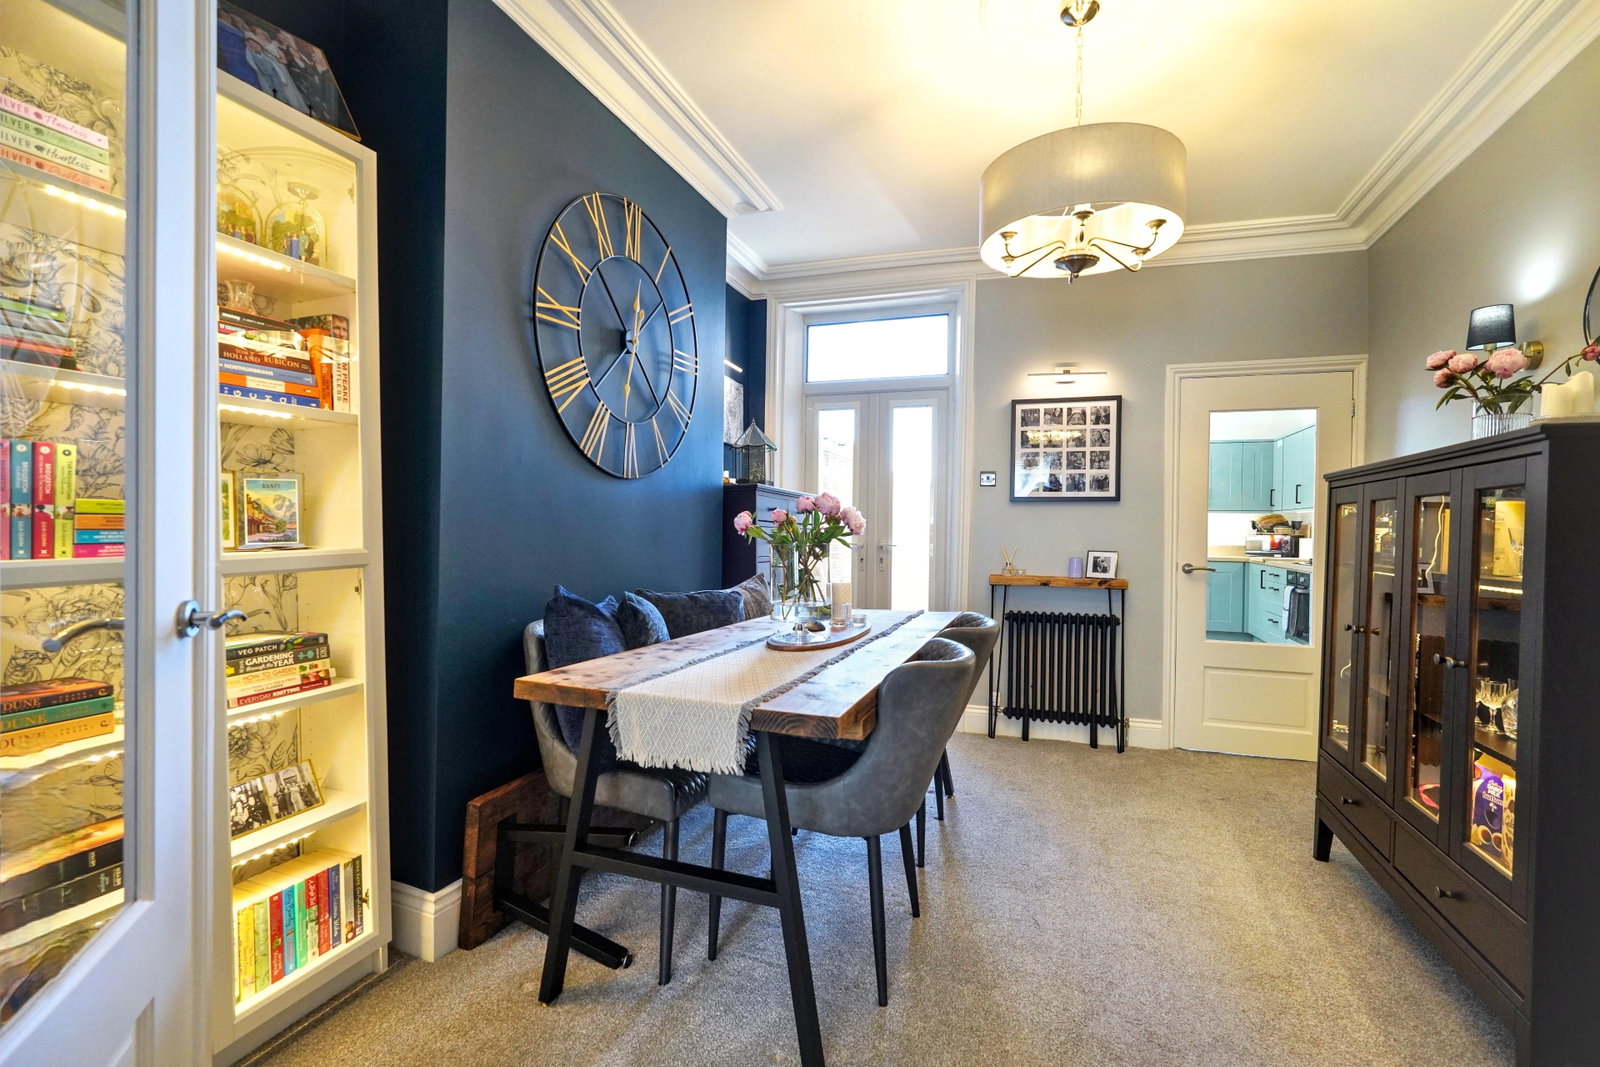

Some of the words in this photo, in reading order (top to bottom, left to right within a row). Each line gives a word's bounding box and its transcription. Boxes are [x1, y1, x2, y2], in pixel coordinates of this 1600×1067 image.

[0, 115, 31, 131] ILVER
[0, 131, 31, 148] ILVER
[46, 146, 91, 171] Heartless
[0, 149, 32, 165] ILVER
[583, 192, 614, 258] XI
[550, 222, 592, 285] X
[655, 246, 672, 284] I
[536, 286, 581, 330] IX
[668, 303, 694, 325] II
[223, 351, 261, 364] HOLLAND
[263, 355, 300, 369] RUBICON
[673, 349, 698, 375] III
[341, 372, 350, 404] PEAKE
[666, 388, 692, 433] IV
[623, 422, 639, 479] VI
[652, 417, 670, 468] V
[22, 461, 30, 493] BRIDGERTON
[44, 463, 52, 494] BRIDGERTON
[238, 646, 253, 656] VEG
[254, 644, 278, 653] PATCH
[245, 651, 295, 666] GARDENING
[273, 658, 295, 667] YEAR
[3, 697, 42, 712] DUNE
[239, 693, 272, 705] EVERYDAY
[272, 686, 301, 697] KNITTING
[0, 713, 47, 731] DUNE
